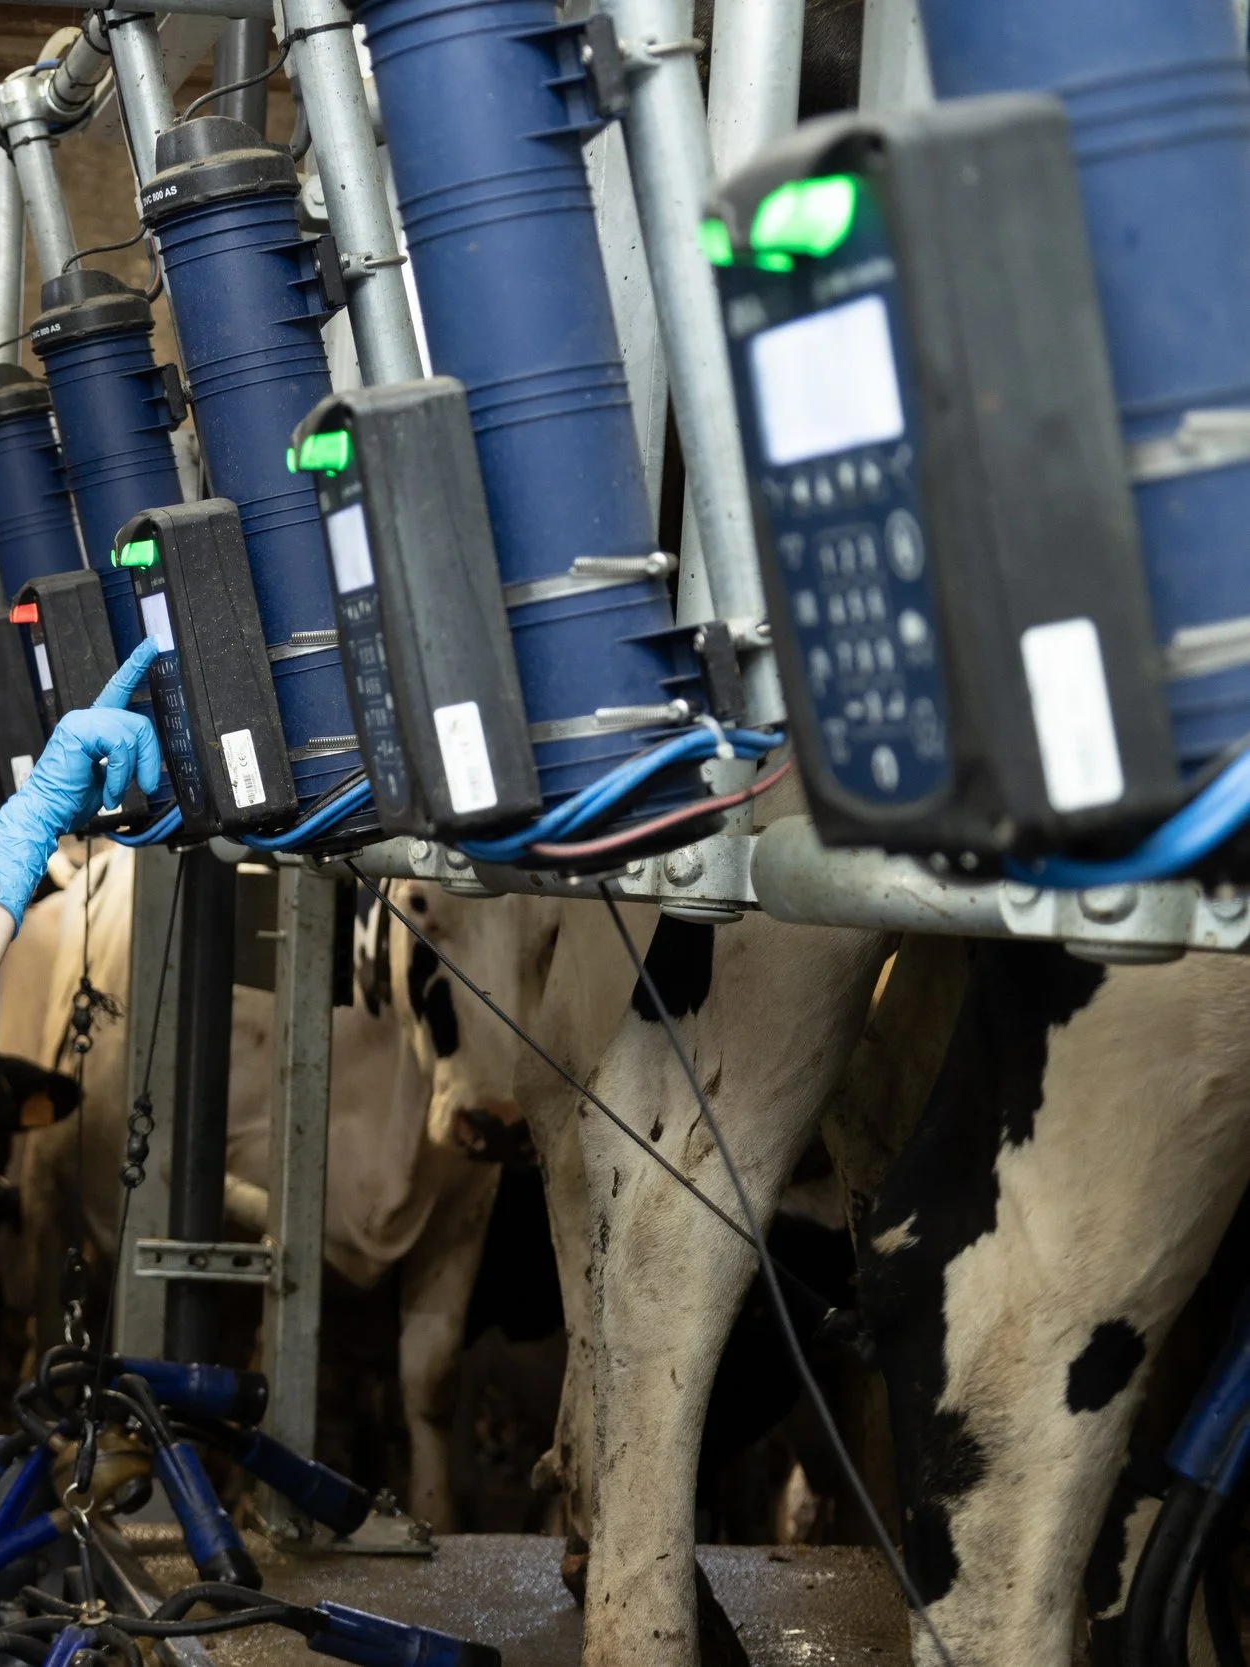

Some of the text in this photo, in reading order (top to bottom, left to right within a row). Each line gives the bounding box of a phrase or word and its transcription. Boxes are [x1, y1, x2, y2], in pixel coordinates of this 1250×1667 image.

[152, 191, 163, 202] 800
[165, 185, 178, 198] AS
[50, 323, 61, 333] AS
